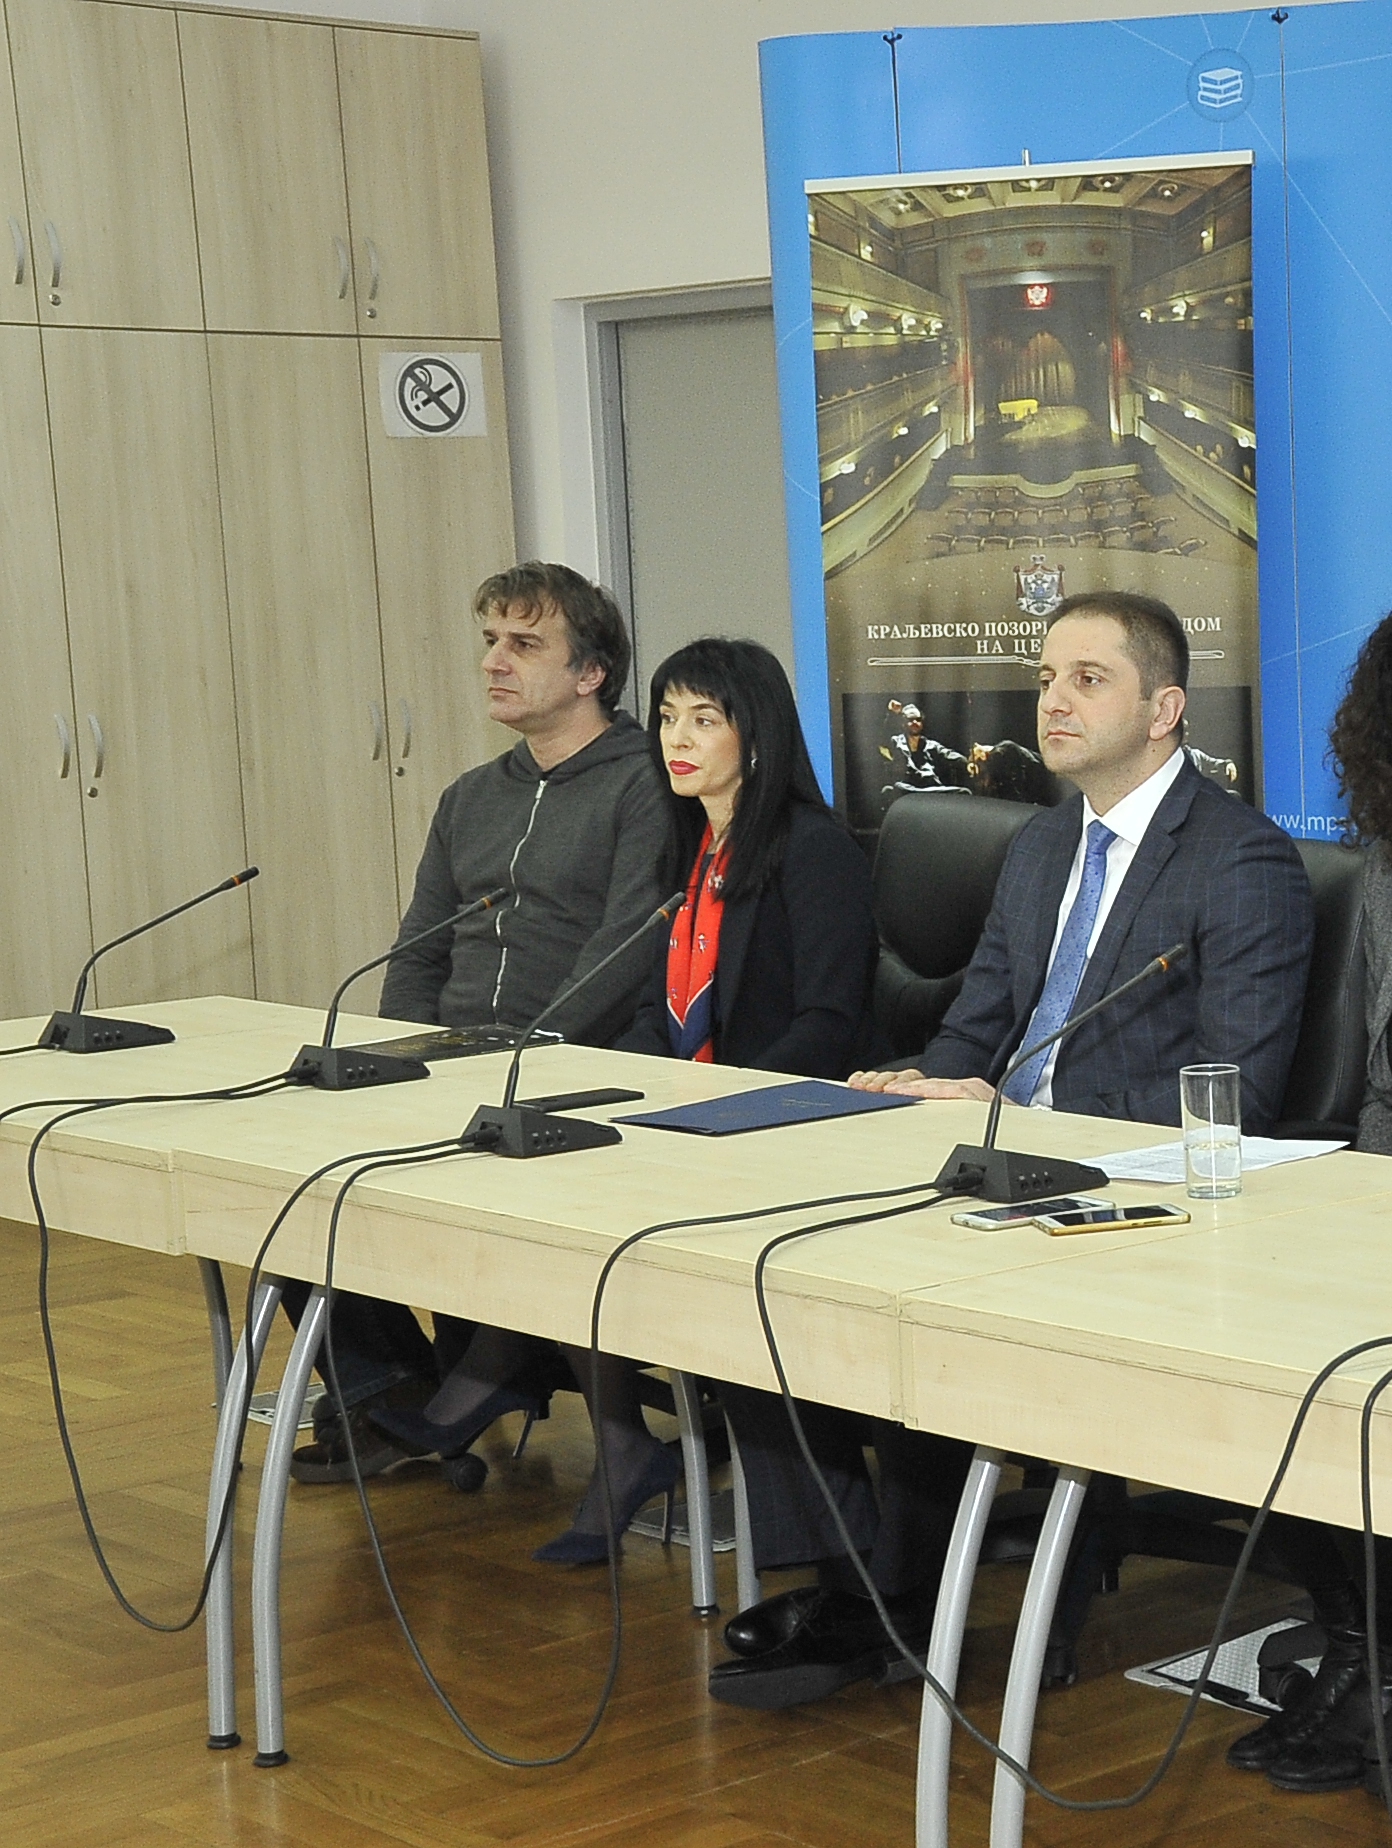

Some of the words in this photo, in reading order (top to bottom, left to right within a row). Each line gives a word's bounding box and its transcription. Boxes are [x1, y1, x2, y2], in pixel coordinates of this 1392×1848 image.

[867, 622, 980, 639] КРАЉЕВСКО
[1182, 616, 1222, 635] ДОМ
[976, 639, 1004, 654] НА
